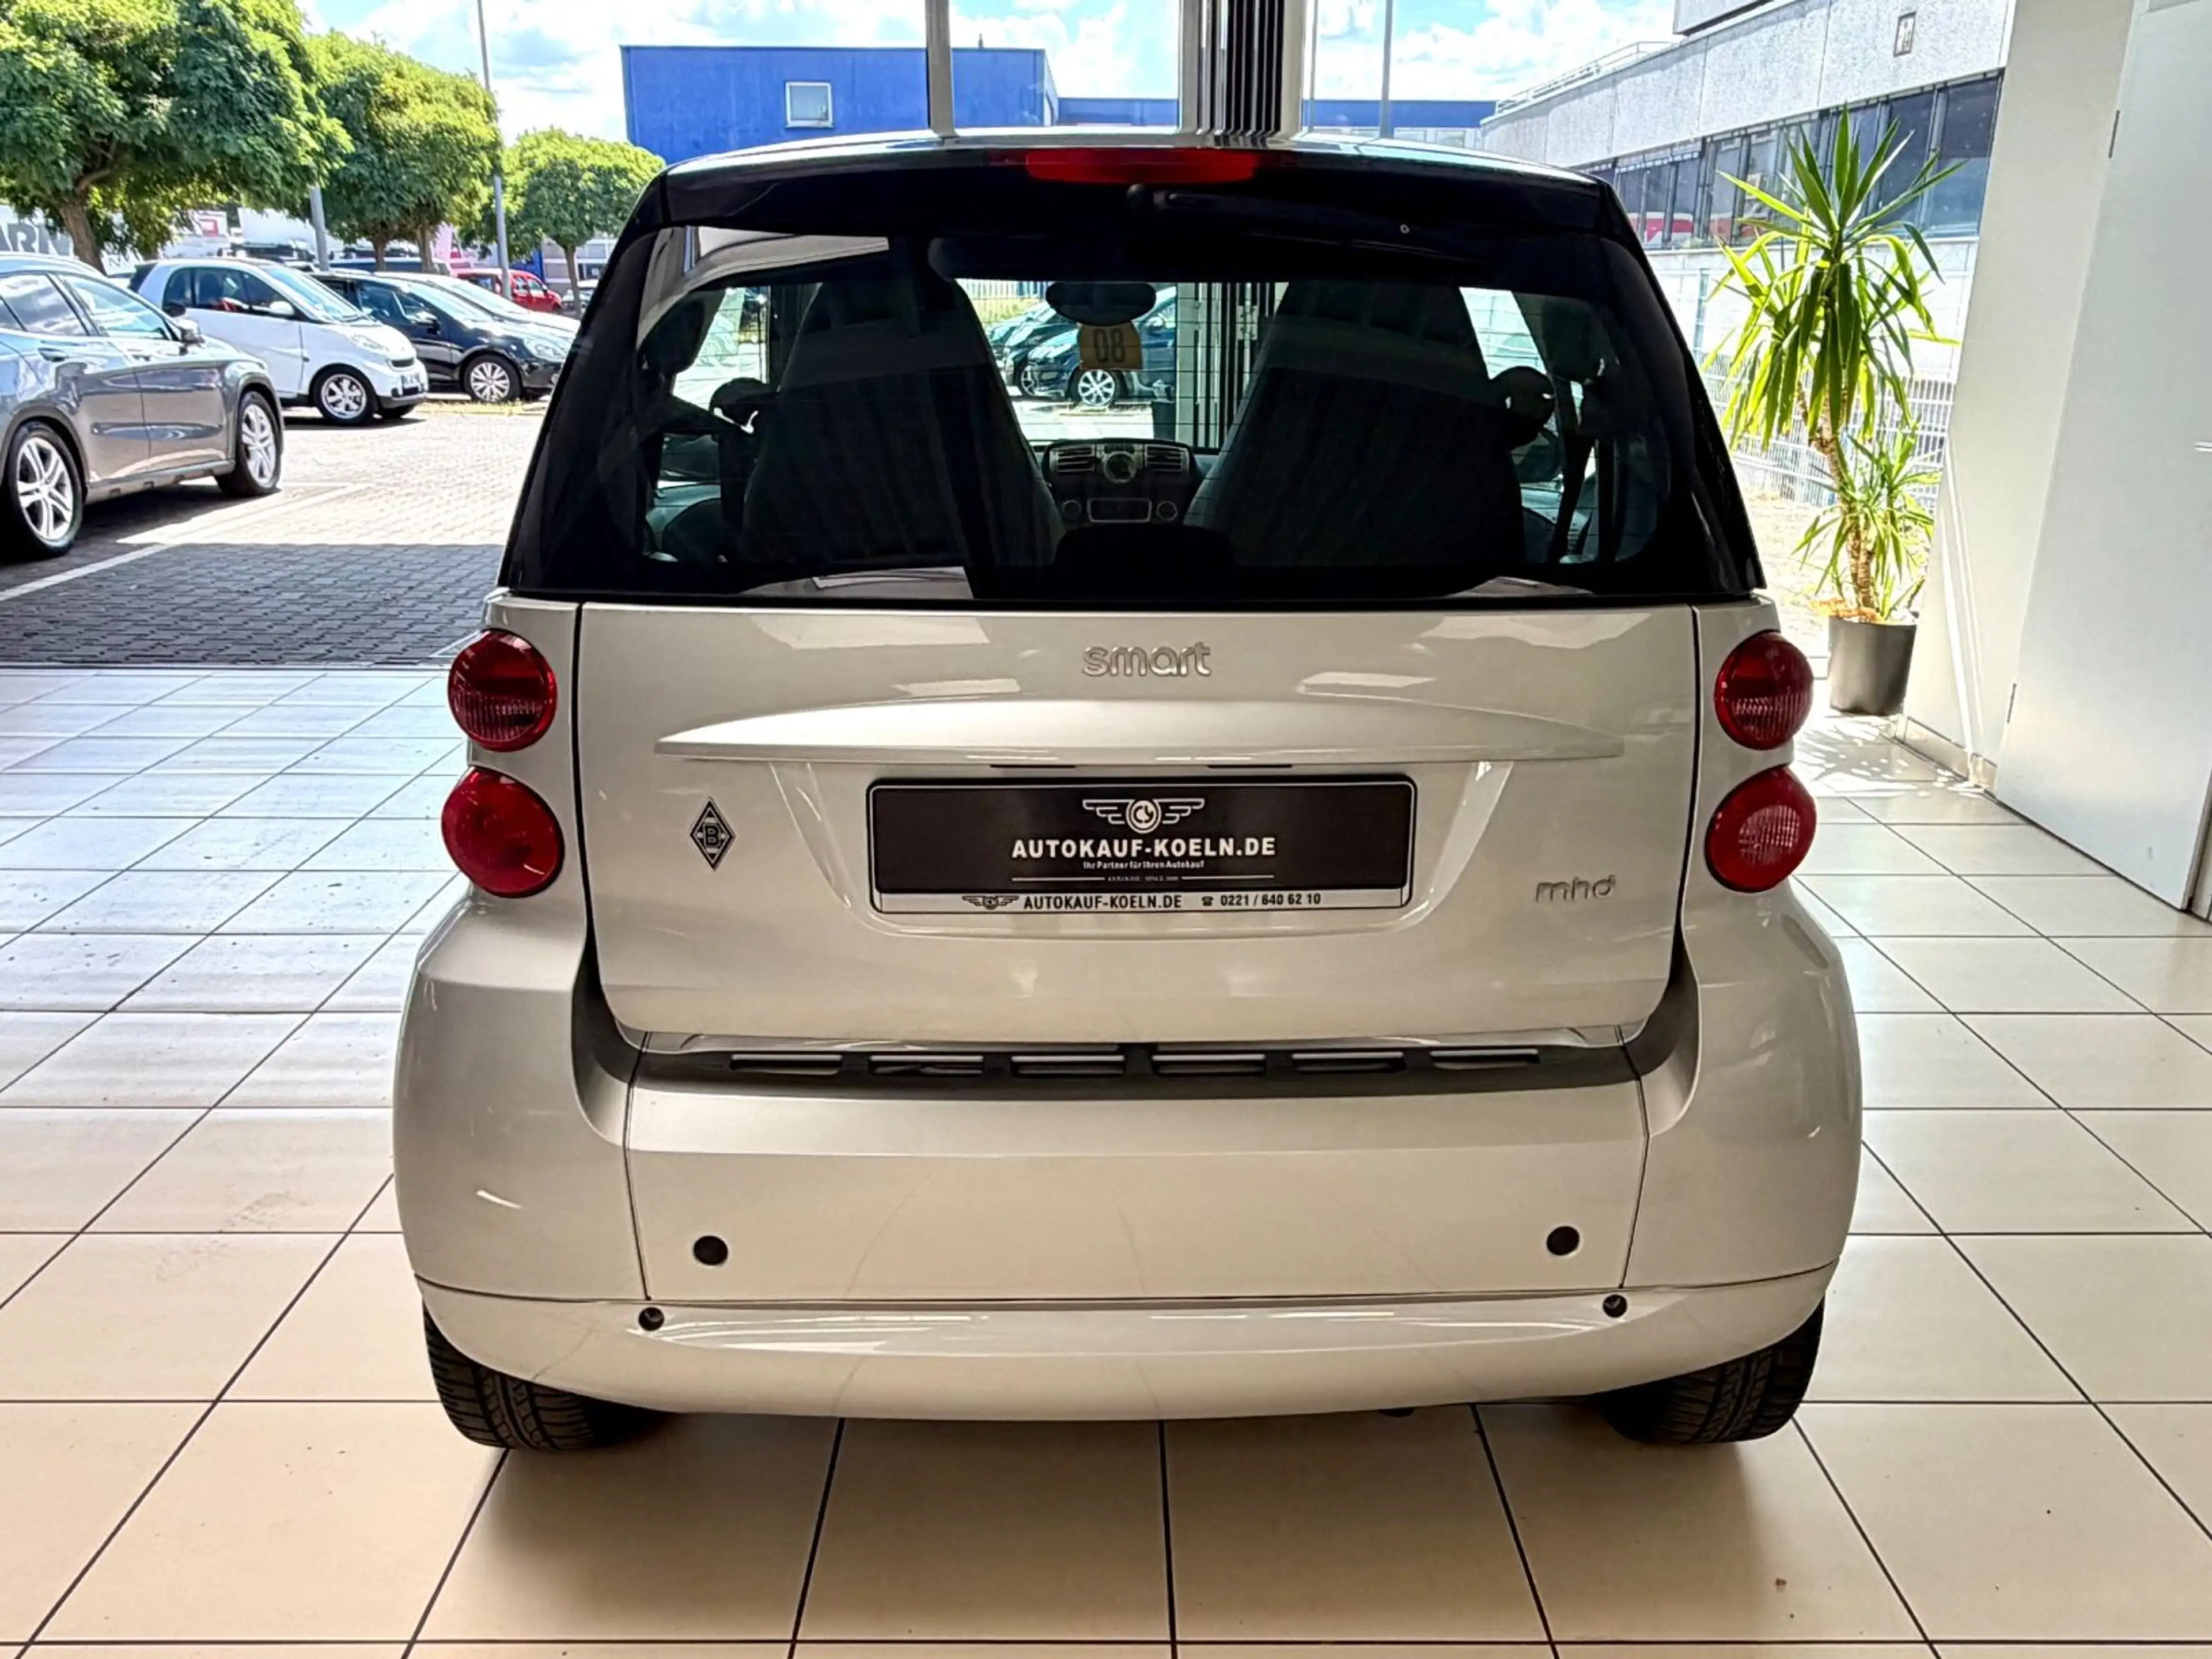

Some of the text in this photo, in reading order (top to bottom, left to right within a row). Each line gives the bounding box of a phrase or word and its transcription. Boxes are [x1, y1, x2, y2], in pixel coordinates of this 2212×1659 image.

[1082, 642, 1211, 676] smart
[1012, 838, 1275, 858] AUTOKAUF-KOELN.DE
[1143, 860, 1164, 868] Ihren
[1165, 859, 1205, 868] Autokauf
[1536, 874, 1616, 902] mhd
[1024, 893, 1321, 909] AUTOKAUF-KOELN.DE 0221 / 640 62 10
